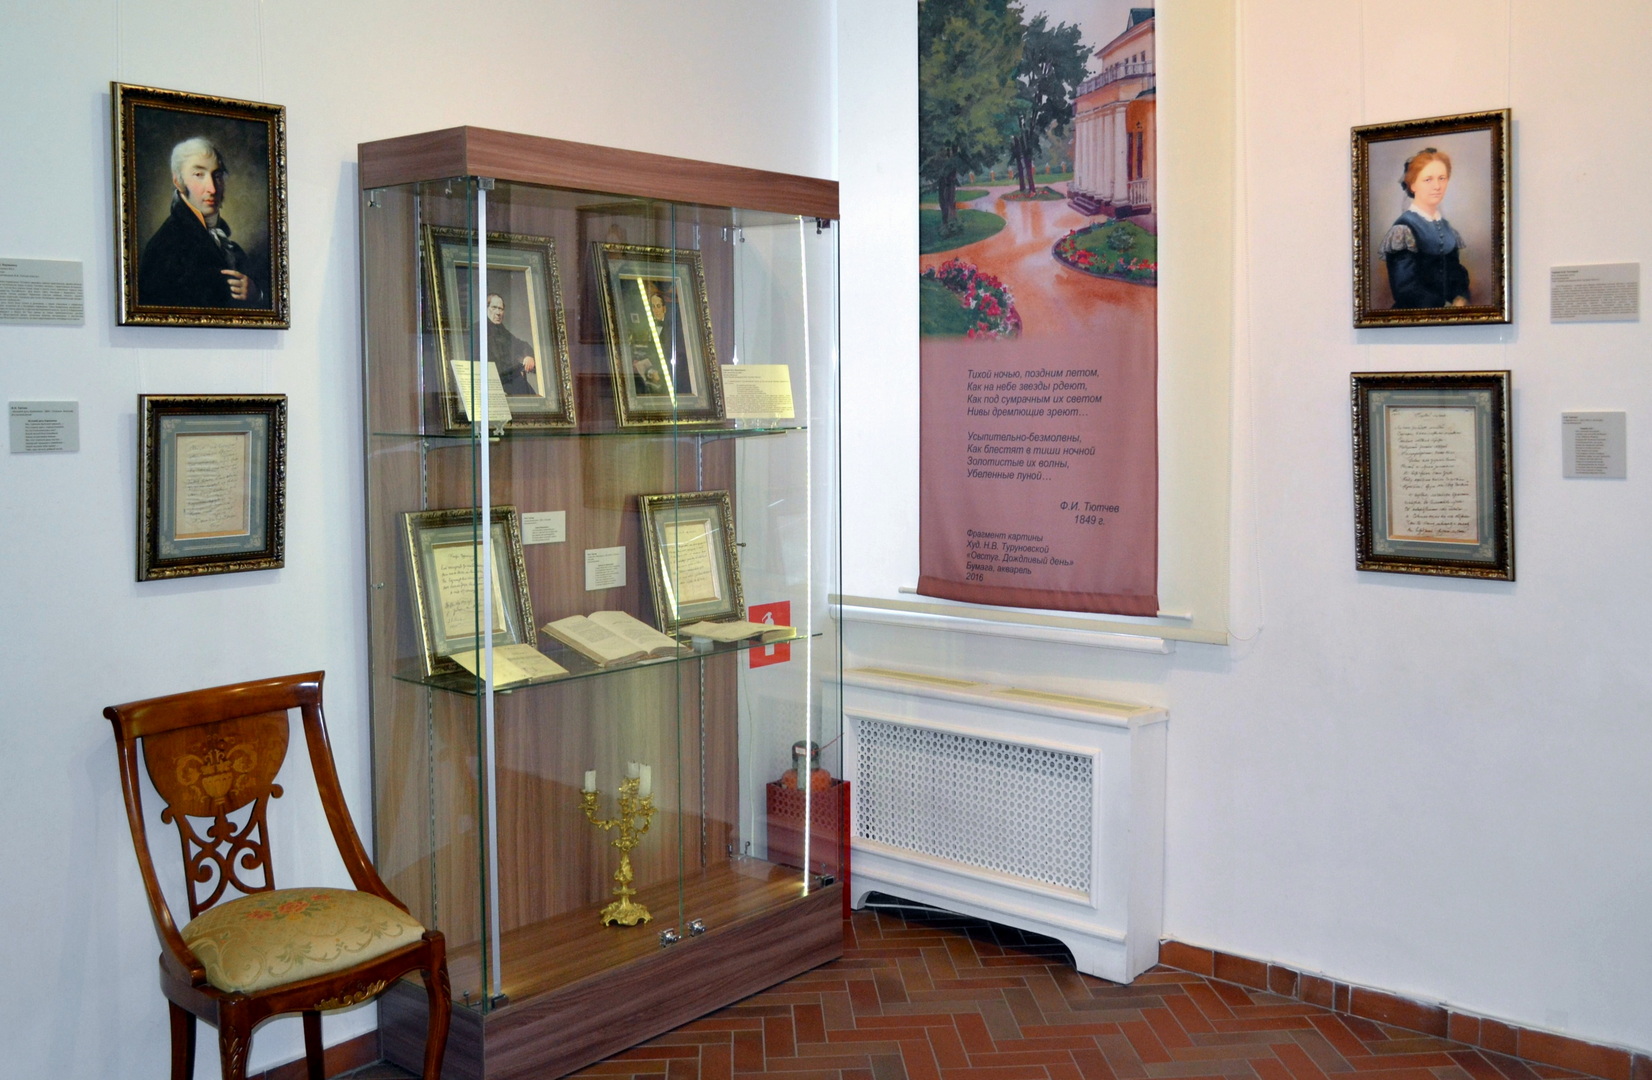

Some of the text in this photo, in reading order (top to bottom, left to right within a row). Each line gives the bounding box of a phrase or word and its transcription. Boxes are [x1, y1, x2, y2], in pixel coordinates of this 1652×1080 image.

[968, 368, 1099, 380] Тихой ночью, поздним летом,
[967, 382, 982, 391] Как
[996, 382, 1017, 391] небе
[1019, 381, 1050, 391] звезды
[1052, 381, 1088, 392] рдеют,
[967, 394, 982, 403] Как
[984, 394, 1000, 404] под
[1001, 396, 1051, 406] сумрачным
[1066, 396, 1102, 404] светом
[967, 407, 990, 416] Нивы
[992, 407, 1044, 418] дремлющие
[968, 431, 1082, 443] Усыпительно-безмолвны,
[967, 444, 982, 453] Как
[984, 444, 1024, 454] блестят
[1033, 447, 1061, 455] тиши
[1063, 446, 1096, 456] ночной
[967, 456, 1025, 467] Золотистые
[1038, 460, 1070, 469] волны,
[968, 468, 1015, 479] Убеленные
[1060, 501, 1120, 513] Ф.И. Тютчев
[1074, 514, 1105, 526] 1849 г.
[967, 529, 1044, 542] Фрагмент картины
[966, 540, 982, 550] Худ.
[984, 541, 999, 551] Н.В.
[1002, 553, 1048, 565] Дождливый
[1049, 556, 1075, 566] день»
[966, 561, 1032, 575] Бумага, акварель
[966, 572, 984, 582] 2016
